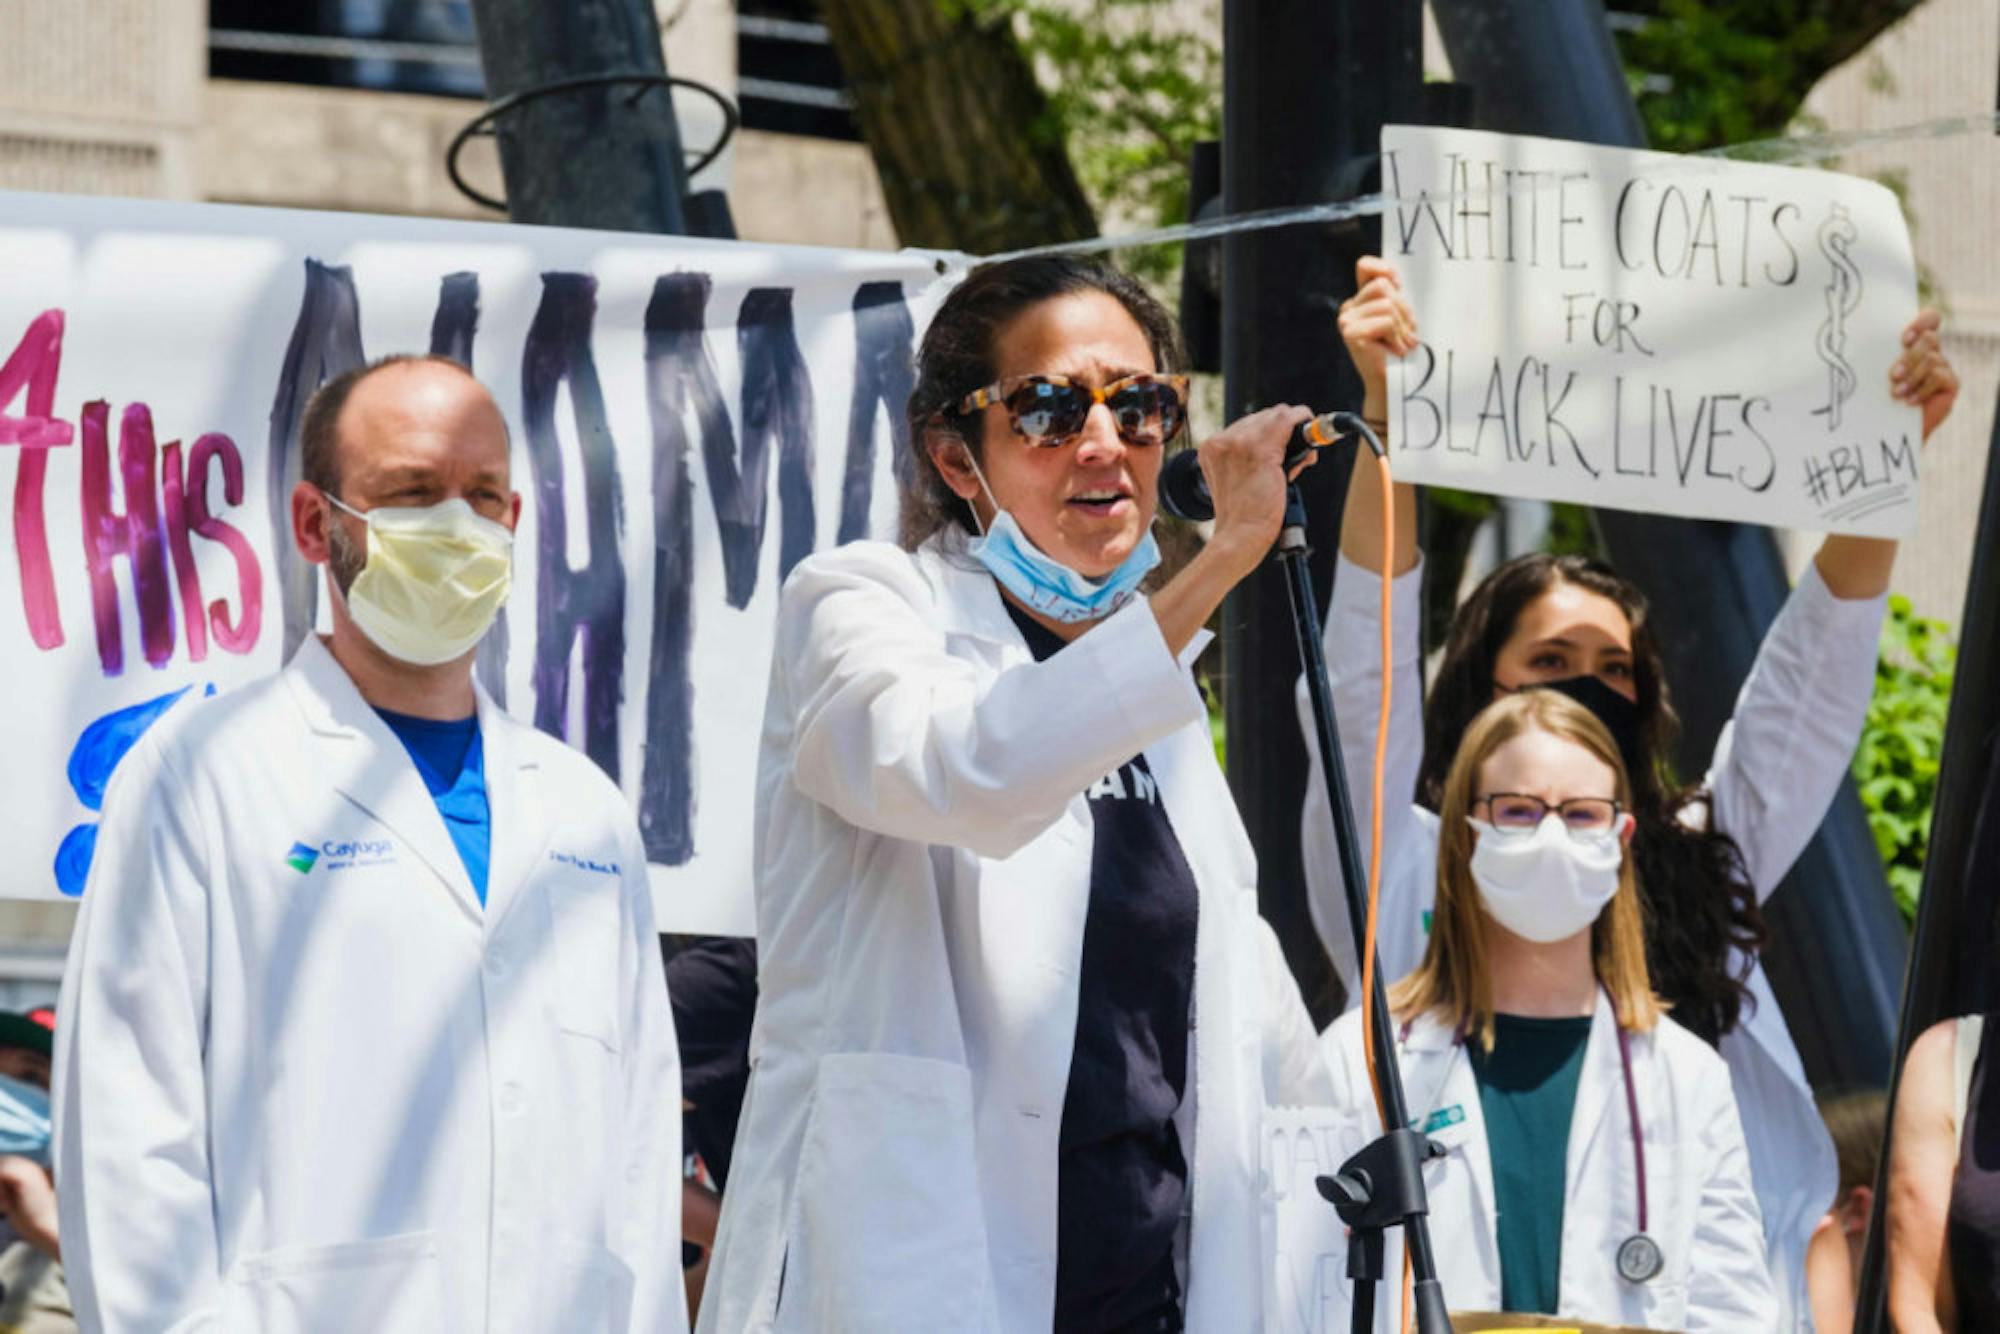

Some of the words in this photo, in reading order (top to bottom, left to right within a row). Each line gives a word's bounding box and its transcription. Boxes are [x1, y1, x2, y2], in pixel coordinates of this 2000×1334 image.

[1382, 149, 1589, 271] WHITE
[1616, 177, 1800, 288] COATS
[1563, 292, 1655, 357] FOR
[1400, 341, 1601, 480] BLACK
[1614, 376, 1777, 494] LIVES
[1802, 435, 1919, 506] #BLM
